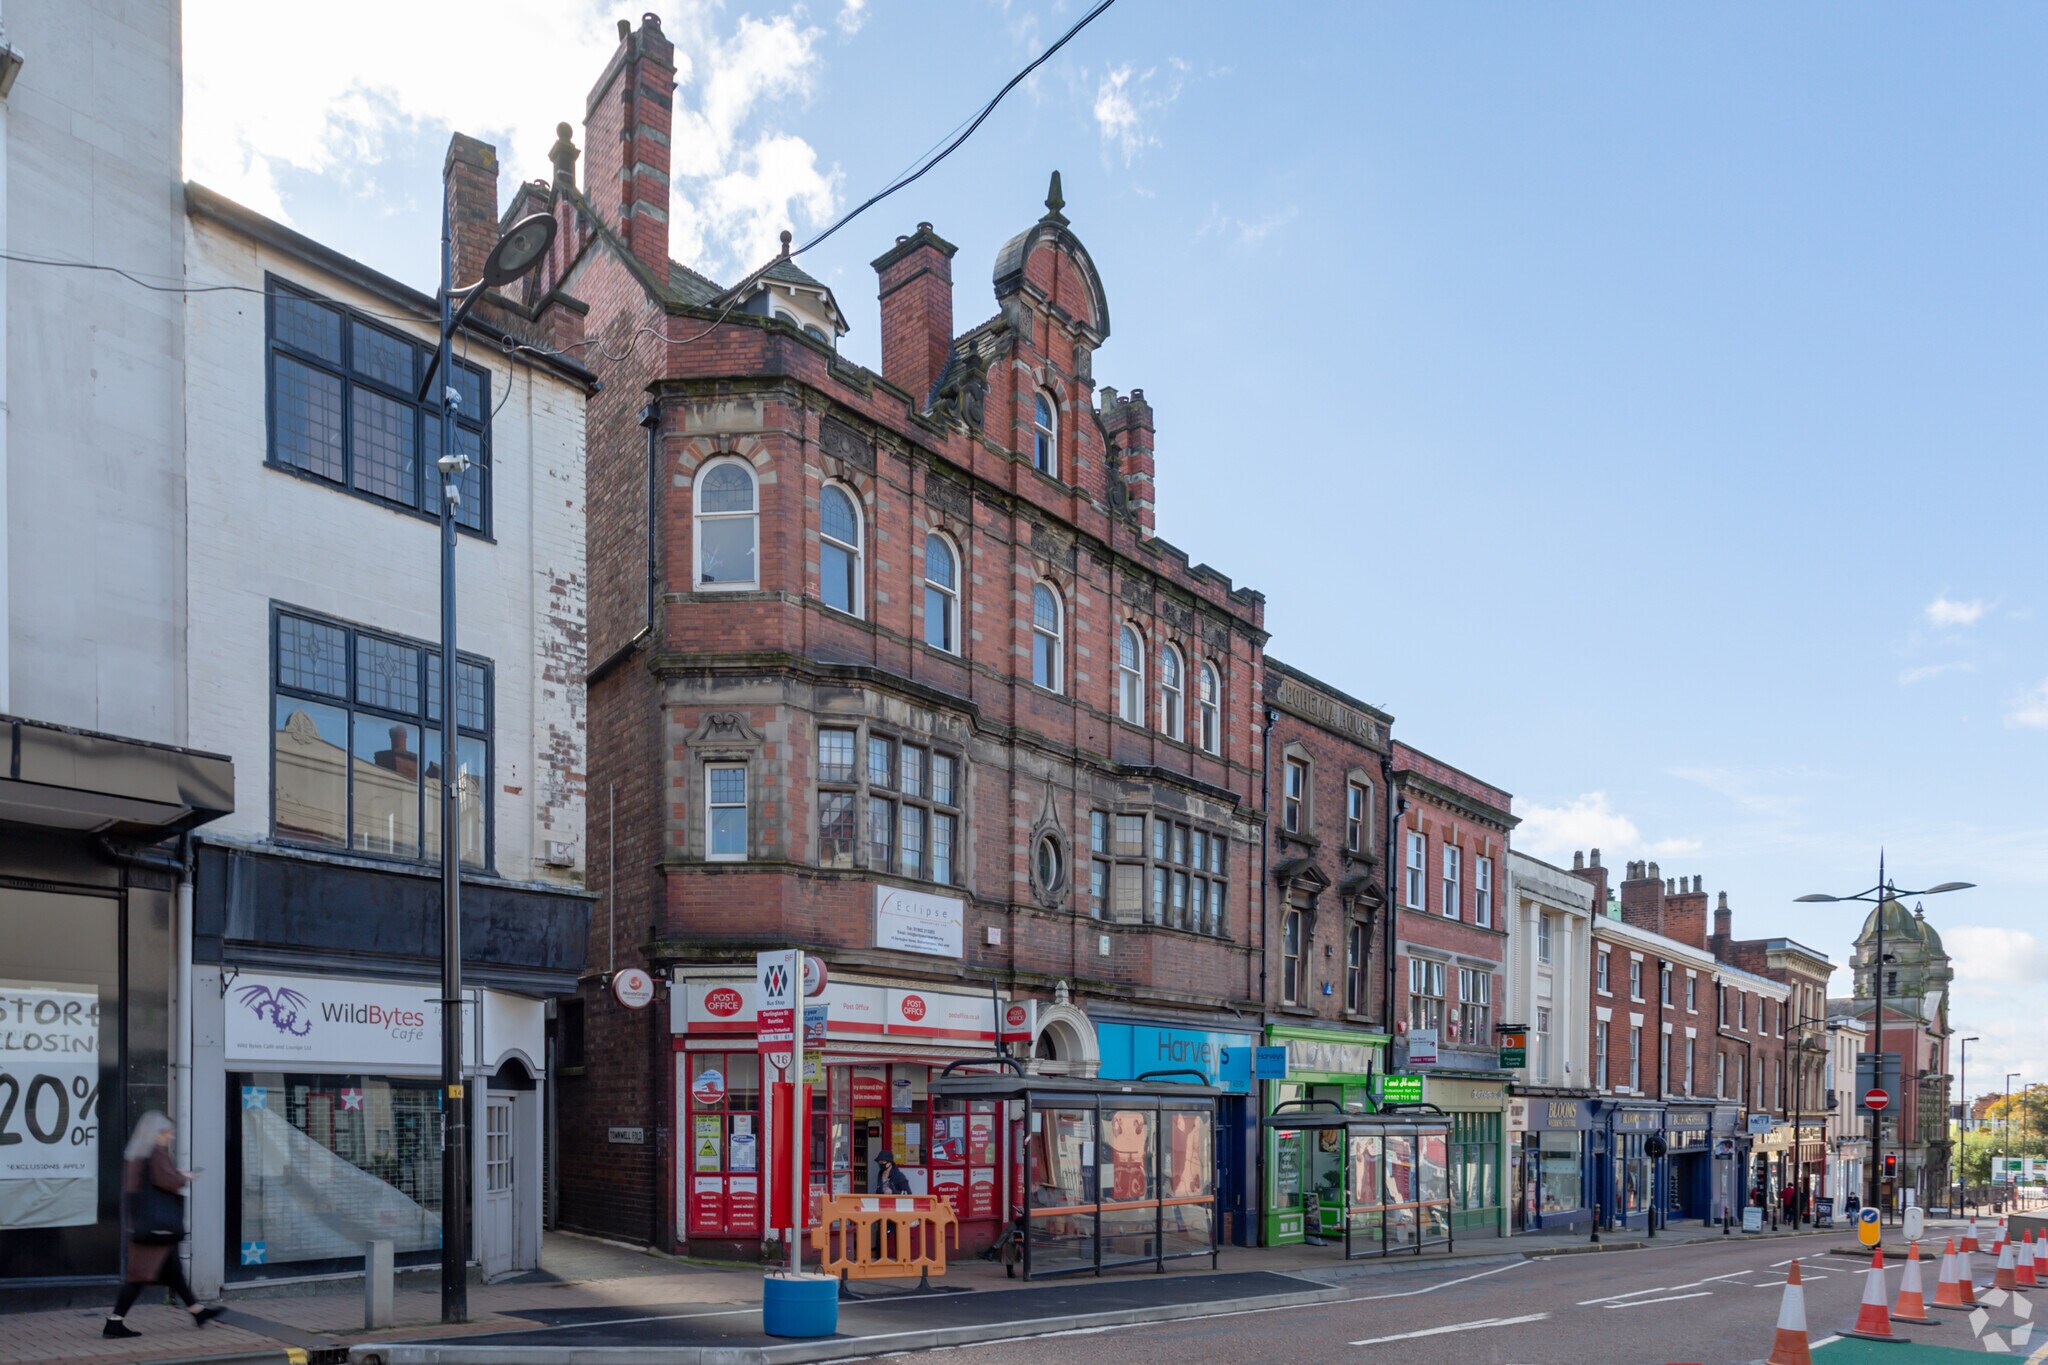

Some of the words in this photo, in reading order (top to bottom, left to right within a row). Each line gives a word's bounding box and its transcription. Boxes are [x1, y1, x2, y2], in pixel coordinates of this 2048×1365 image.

[1286, 682, 1336, 725] BOHEMIA
[1340, 708, 1376, 740] HOUSE
[896, 900, 948, 919] Eclipse
[708, 1002, 738, 1010] OFFICE
[855, 1003, 869, 1011] Office
[907, 999, 921, 1008] POST
[321, 1002, 424, 1029] WildBytes
[904, 1007, 923, 1016] OFFICE
[949, 1012, 980, 1020] postoffice.co.uk
[391, 1027, 424, 1043] Café
[0, 1031, 99, 1053] LOSIN
[776, 1055, 788, 1064] 16
[1158, 1031, 1230, 1078] Harveys
[1257, 1052, 1284, 1061] Harveys
[1548, 1102, 1576, 1118] BLOOMS
